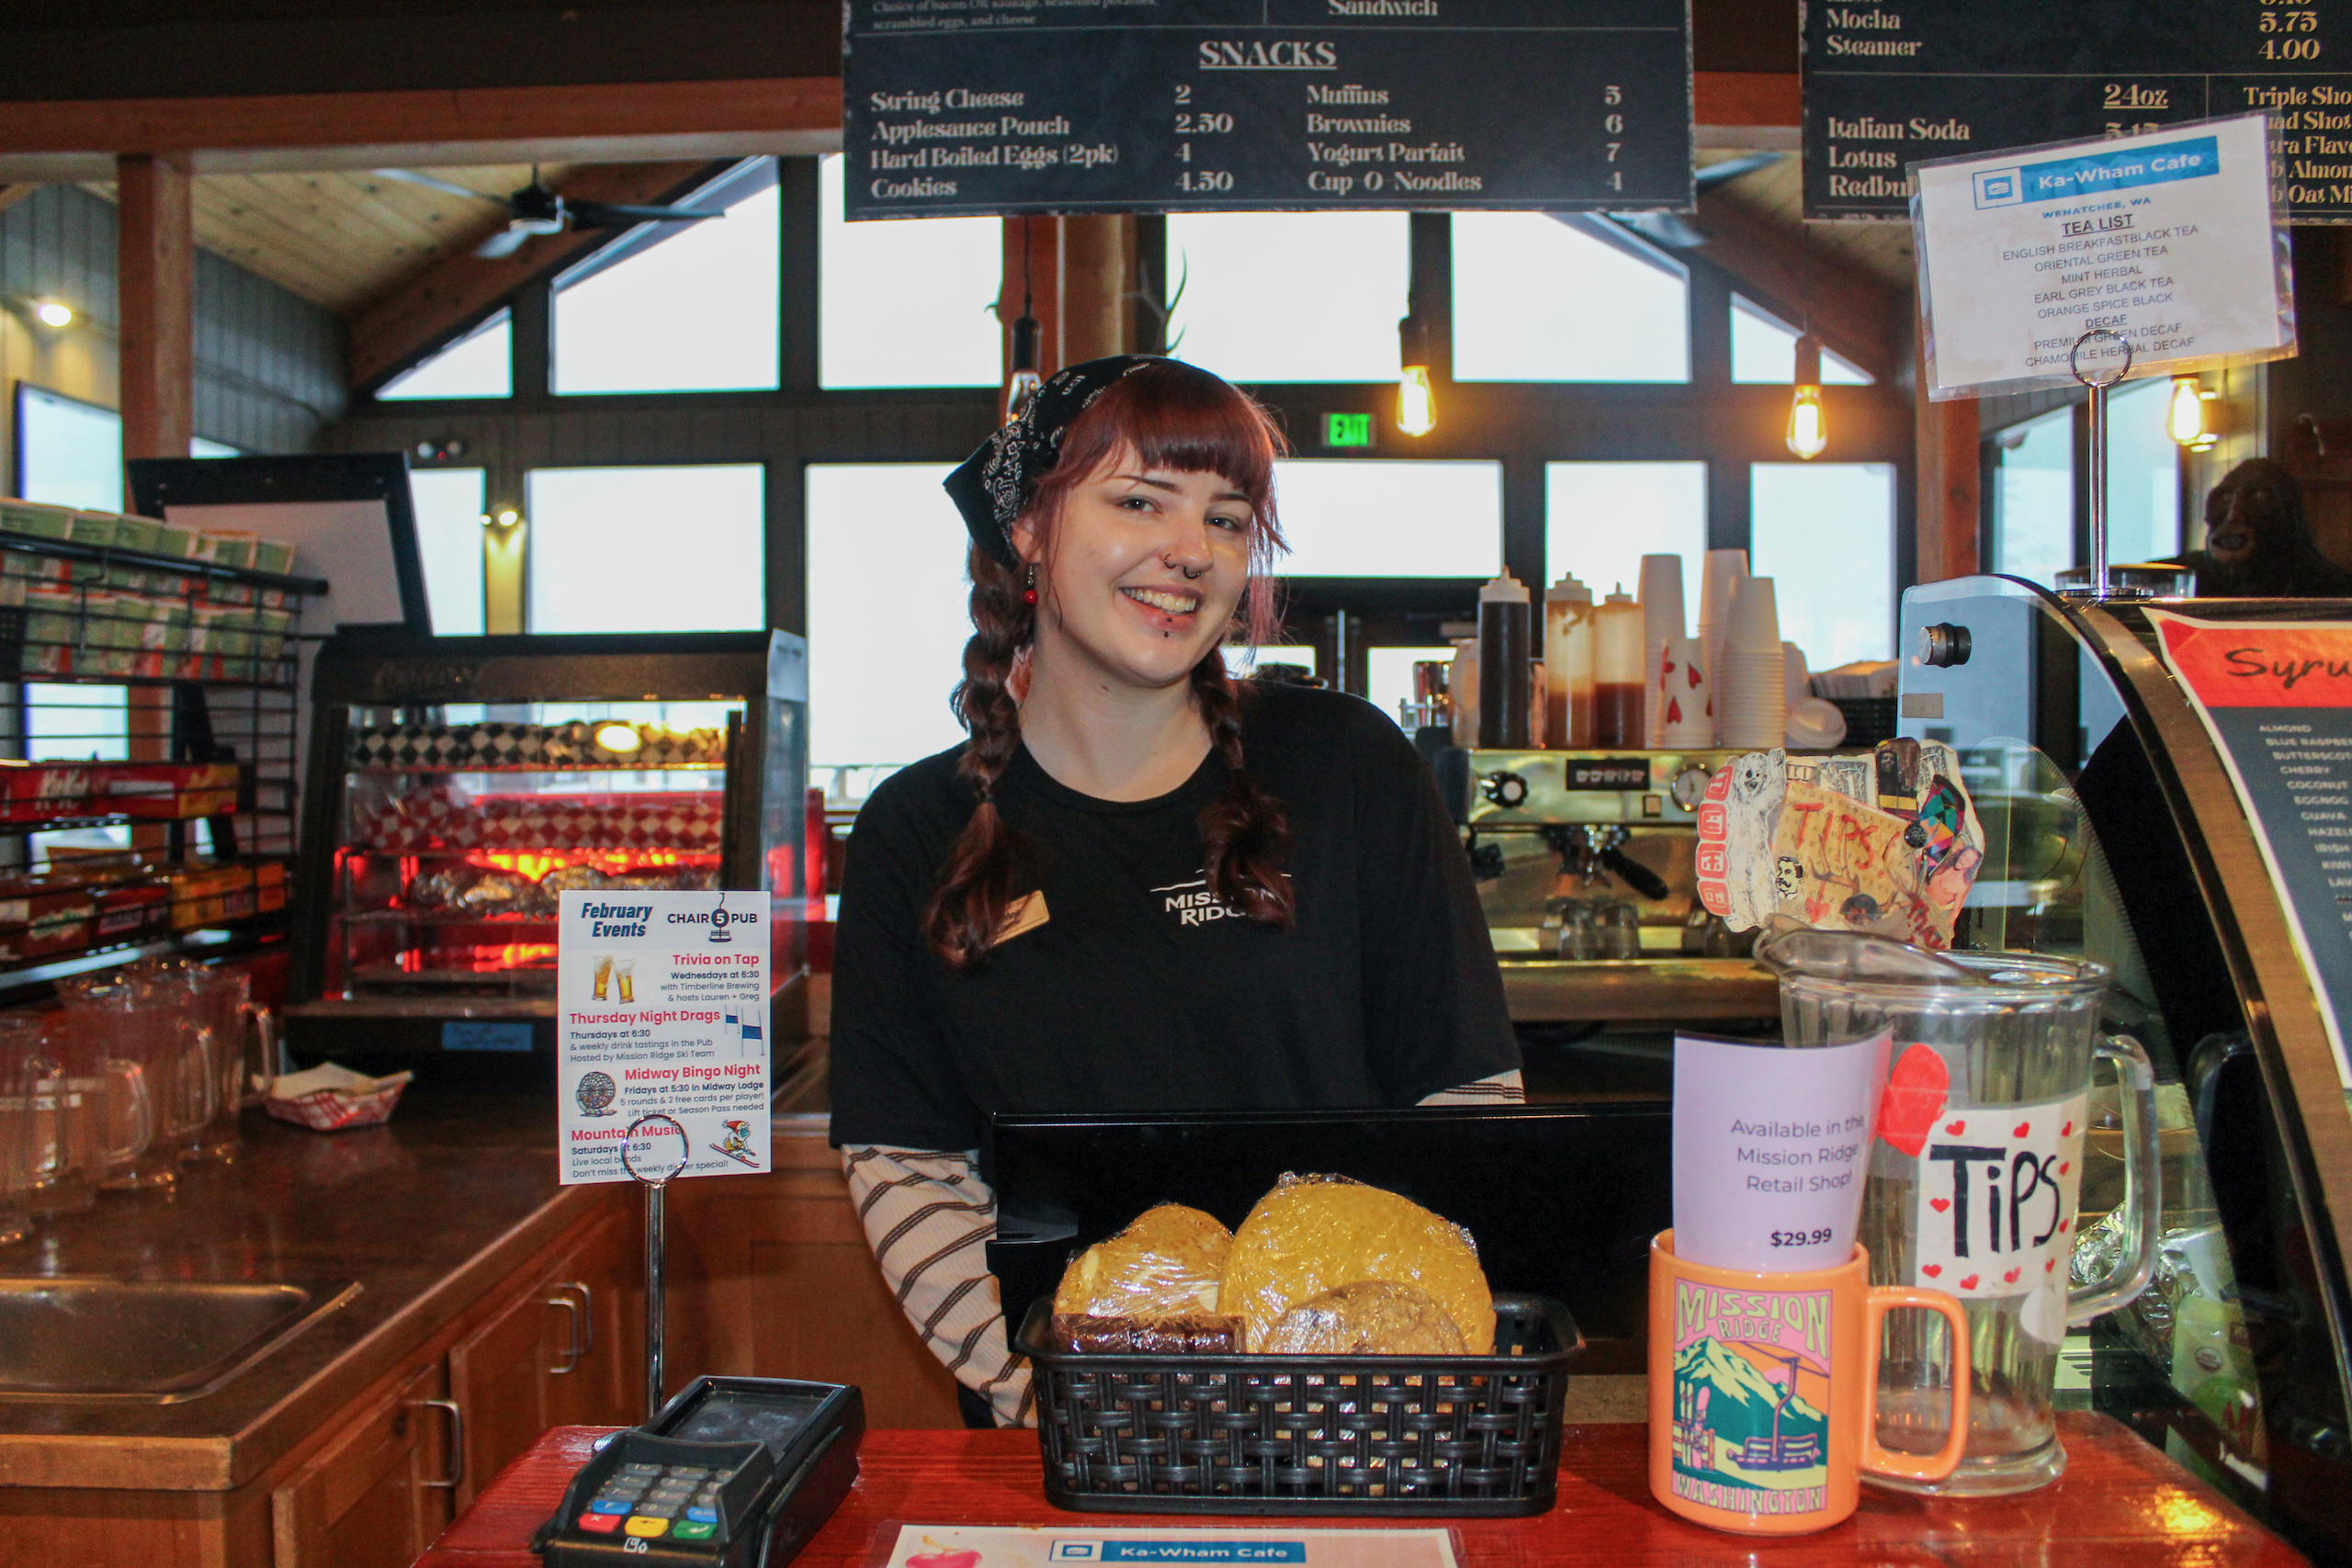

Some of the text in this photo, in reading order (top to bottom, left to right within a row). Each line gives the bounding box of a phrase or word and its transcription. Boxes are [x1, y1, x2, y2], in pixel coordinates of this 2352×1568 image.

[1329, 0, 1438, 16] Sandwich
[1826, 8, 2317, 33] Mocha 5.75
[1199, 40, 1337, 67] SNACKS
[1826, 35, 2321, 60] Steamer 4.00
[871, 85, 1191, 114] String Cheese 2
[1306, 84, 1388, 105] Muffins
[2244, 86, 2307, 109] Triple
[1828, 84, 2168, 140] Italian Soda 24oz
[871, 113, 1233, 142] Applesauce Pouch 2.50
[1306, 113, 1623, 134] Brownies 6
[871, 142, 1191, 170] Hard Boiled Eggs (2pk) 4
[1306, 141, 1621, 165] Yogurt Parfait 7
[1829, 146, 1897, 168] Lotus
[2038, 152, 2202, 189] Ka-Wham Cafe
[871, 171, 1233, 198] Cookies 4.50
[1607, 172, 1623, 191] 4
[2288, 185, 2325, 204] Oat
[2042, 197, 2151, 219] WENATCHEE, WA
[2062, 214, 2133, 235] TEA LIST
[2003, 245, 2055, 261] ENGLISH
[2177, 225, 2199, 236] TEA
[2034, 245, 2168, 272] ORIENTAL GREEN TEA
[2062, 265, 2143, 284] MINT HERBAL
[2034, 276, 2174, 303] EARL GREY BLACK TEA
[2038, 292, 2173, 319] ORANGE SPICE BLACK
[2086, 314, 2127, 328] DECAF
[2141, 322, 2182, 336] DECAF
[2153, 337, 2195, 351] DECAF
[1329, 413, 1371, 446] EXIT
[2259, 725, 2312, 733] ALMOND
[2266, 738, 2297, 746] BLUE
[2280, 766, 2330, 774] CHERRY
[2287, 781, 2348, 790] COCONUT
[2294, 795, 2349, 805] EGGNOG
[2301, 811, 2346, 820] GUAVA
[582, 902, 653, 920] February
[668, 913, 758, 923] CHAIR 5 PUB
[593, 921, 646, 937] Events
[673, 953, 759, 967] Trivia on Tap
[672, 971, 728, 980] Wednesdays
[681, 982, 724, 990] Timberline
[727, 982, 759, 991] Brewing
[740, 993, 759, 1002] Greg
[570, 1010, 719, 1026] Thursday Night Drags
[571, 1031, 617, 1040] Thursdays
[631, 1029, 650, 1037] 6:30
[579, 1042, 609, 1052] weekly
[612, 1041, 633, 1050] drink
[635, 1040, 669, 1050] tastings
[682, 1039, 695, 1047] the
[571, 1054, 601, 1062] Hosted
[604, 1053, 614, 1063] by
[616, 1052, 649, 1060] Mission
[650, 1051, 674, 1061] Ridge
[677, 1050, 689, 1058] Ski
[625, 1064, 761, 1082] Midway Bingo Night
[625, 1086, 657, 1096] Fridays
[702, 1082, 736, 1092] Midway
[738, 1081, 763, 1091] Lodge
[628, 1097, 658, 1105] rounds
[675, 1095, 692, 1103] free
[694, 1094, 718, 1102] cards
[720, 1095, 733, 1103] per
[736, 1092, 763, 1102] player!
[628, 1108, 640, 1117] Lift
[642, 1107, 666, 1116] ticket
[1731, 1114, 1864, 1137] Available in the
[572, 1143, 651, 1155] Saturdays 6:30
[1737, 1144, 1859, 1165] Mission Ridge
[573, 1169, 595, 1178] Don't
[637, 1165, 664, 1173] weekly
[696, 1159, 728, 1170] special!
[592, 1156, 612, 1165] local
[1747, 1169, 1852, 1192] Retail Shop!
[1770, 1227, 1832, 1248] $29.99
[1676, 1282, 1828, 1360] MISSION
[1718, 1318, 1785, 1343] RIDGE
[1676, 1472, 1821, 1514] WASHINGTON
[1120, 1547, 1288, 1558] Ka-Wham Cafe
